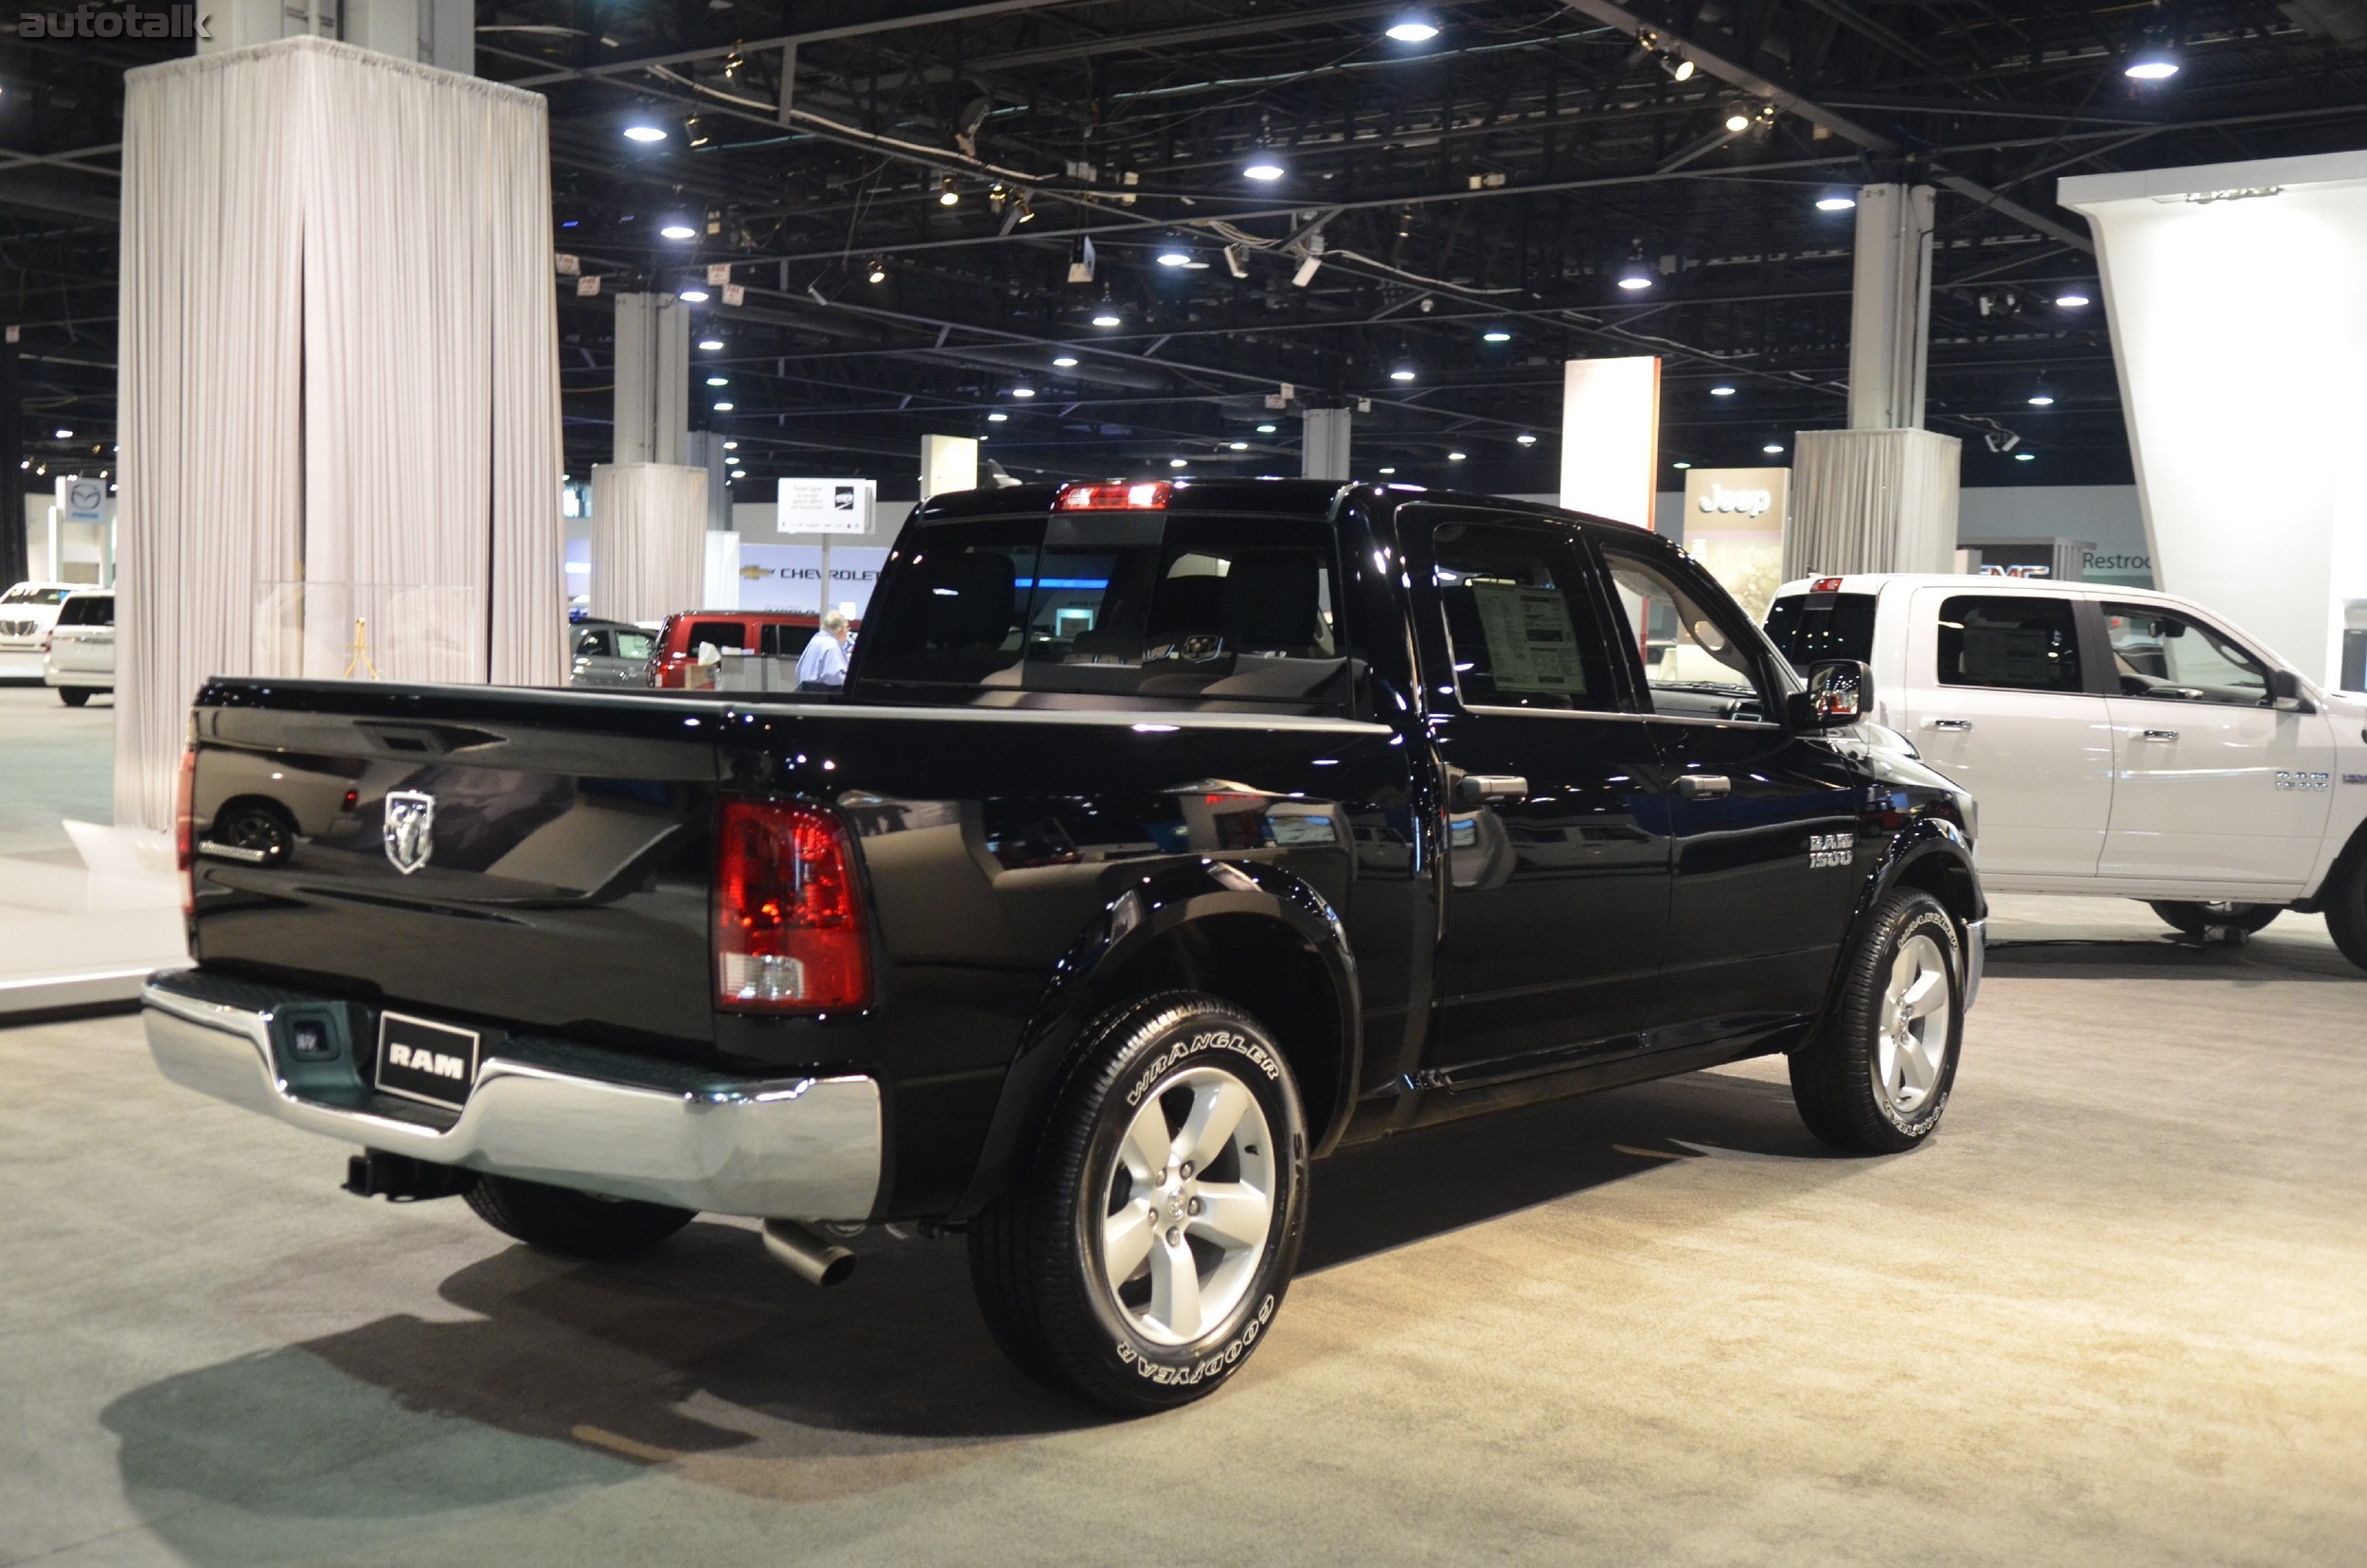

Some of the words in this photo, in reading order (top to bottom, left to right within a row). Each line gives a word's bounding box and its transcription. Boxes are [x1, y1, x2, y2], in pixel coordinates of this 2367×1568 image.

[1699, 483, 1771, 519] Jeep
[1809, 833, 1854, 851] RAM
[1809, 850, 1853, 868] 1500
[389, 1042, 465, 1080] RAM
[1127, 1030, 1281, 1108] WRANGLER
[1116, 1292, 1276, 1387] GOODYEAR
